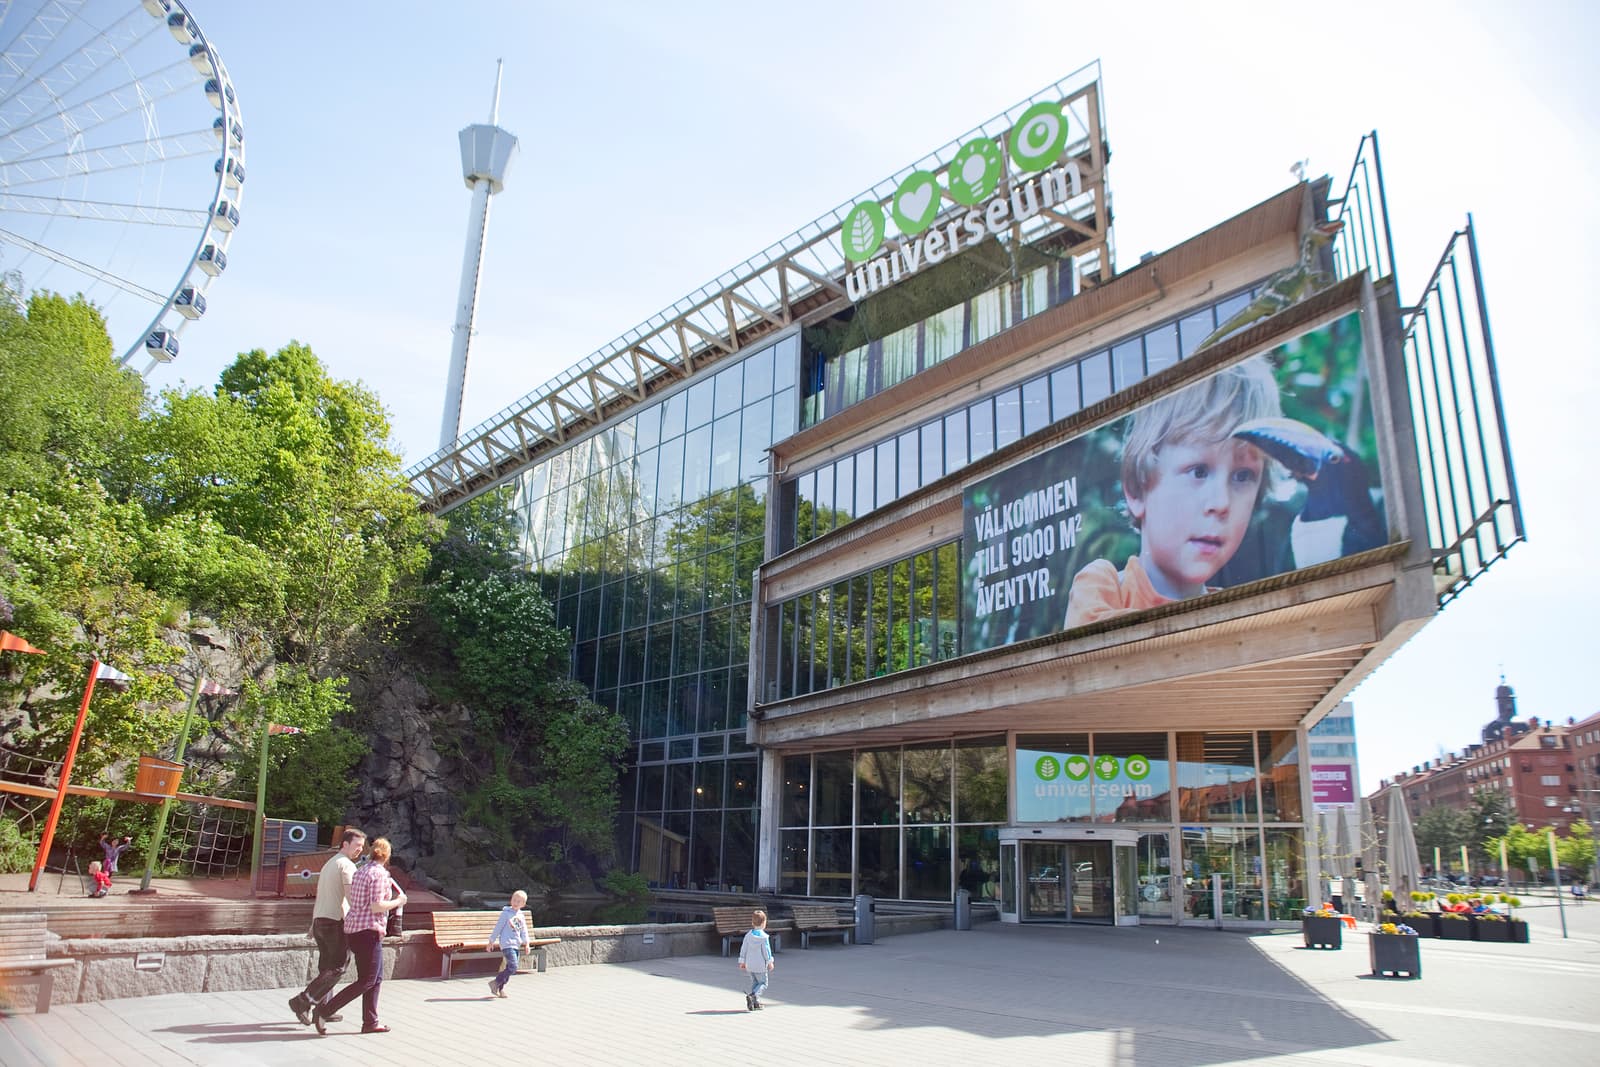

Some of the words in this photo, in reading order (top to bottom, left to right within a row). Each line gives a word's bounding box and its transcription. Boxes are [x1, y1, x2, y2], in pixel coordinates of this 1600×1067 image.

[845, 161, 1082, 302] universeum
[974, 476, 1078, 543] VÄLKOMMEN
[975, 542, 1009, 578] TILL
[1011, 525, 1055, 567] 9000
[975, 567, 1056, 617] ÄVENTYR.
[1035, 783, 1152, 797] universeum
